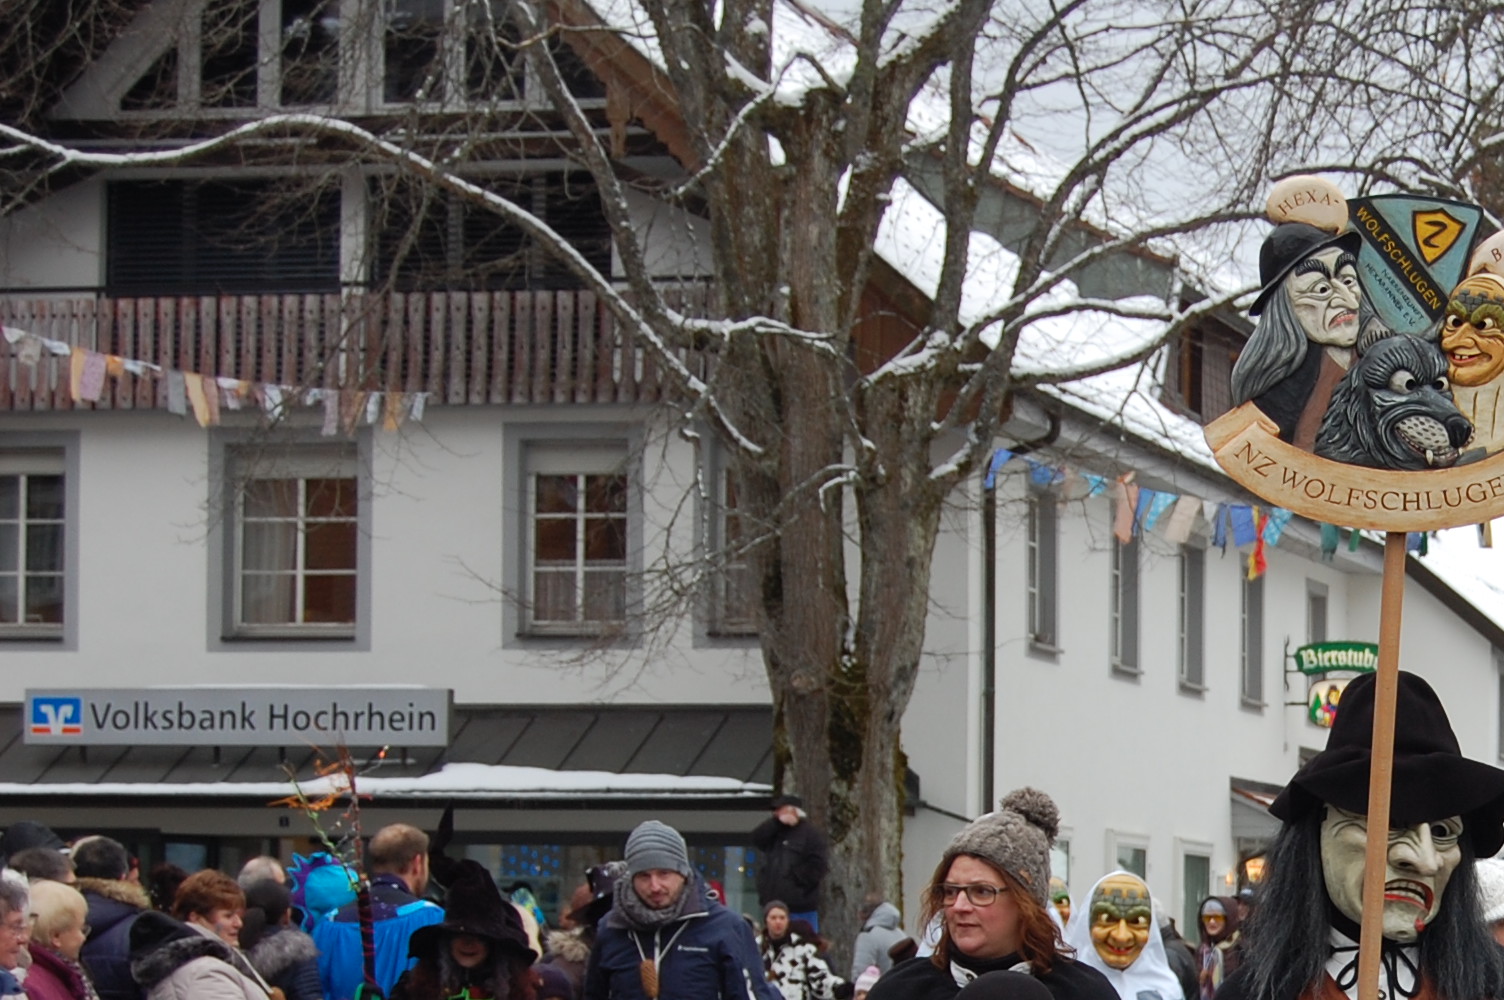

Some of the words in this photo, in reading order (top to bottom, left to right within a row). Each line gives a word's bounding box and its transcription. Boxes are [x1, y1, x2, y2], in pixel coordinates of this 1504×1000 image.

[1356, 206, 1442, 310] WOLFSCHLUGEN
[1233, 440, 1277, 478] NZ
[90, 700, 256, 731] Volksbank
[268, 701, 437, 732] Hochrhein
